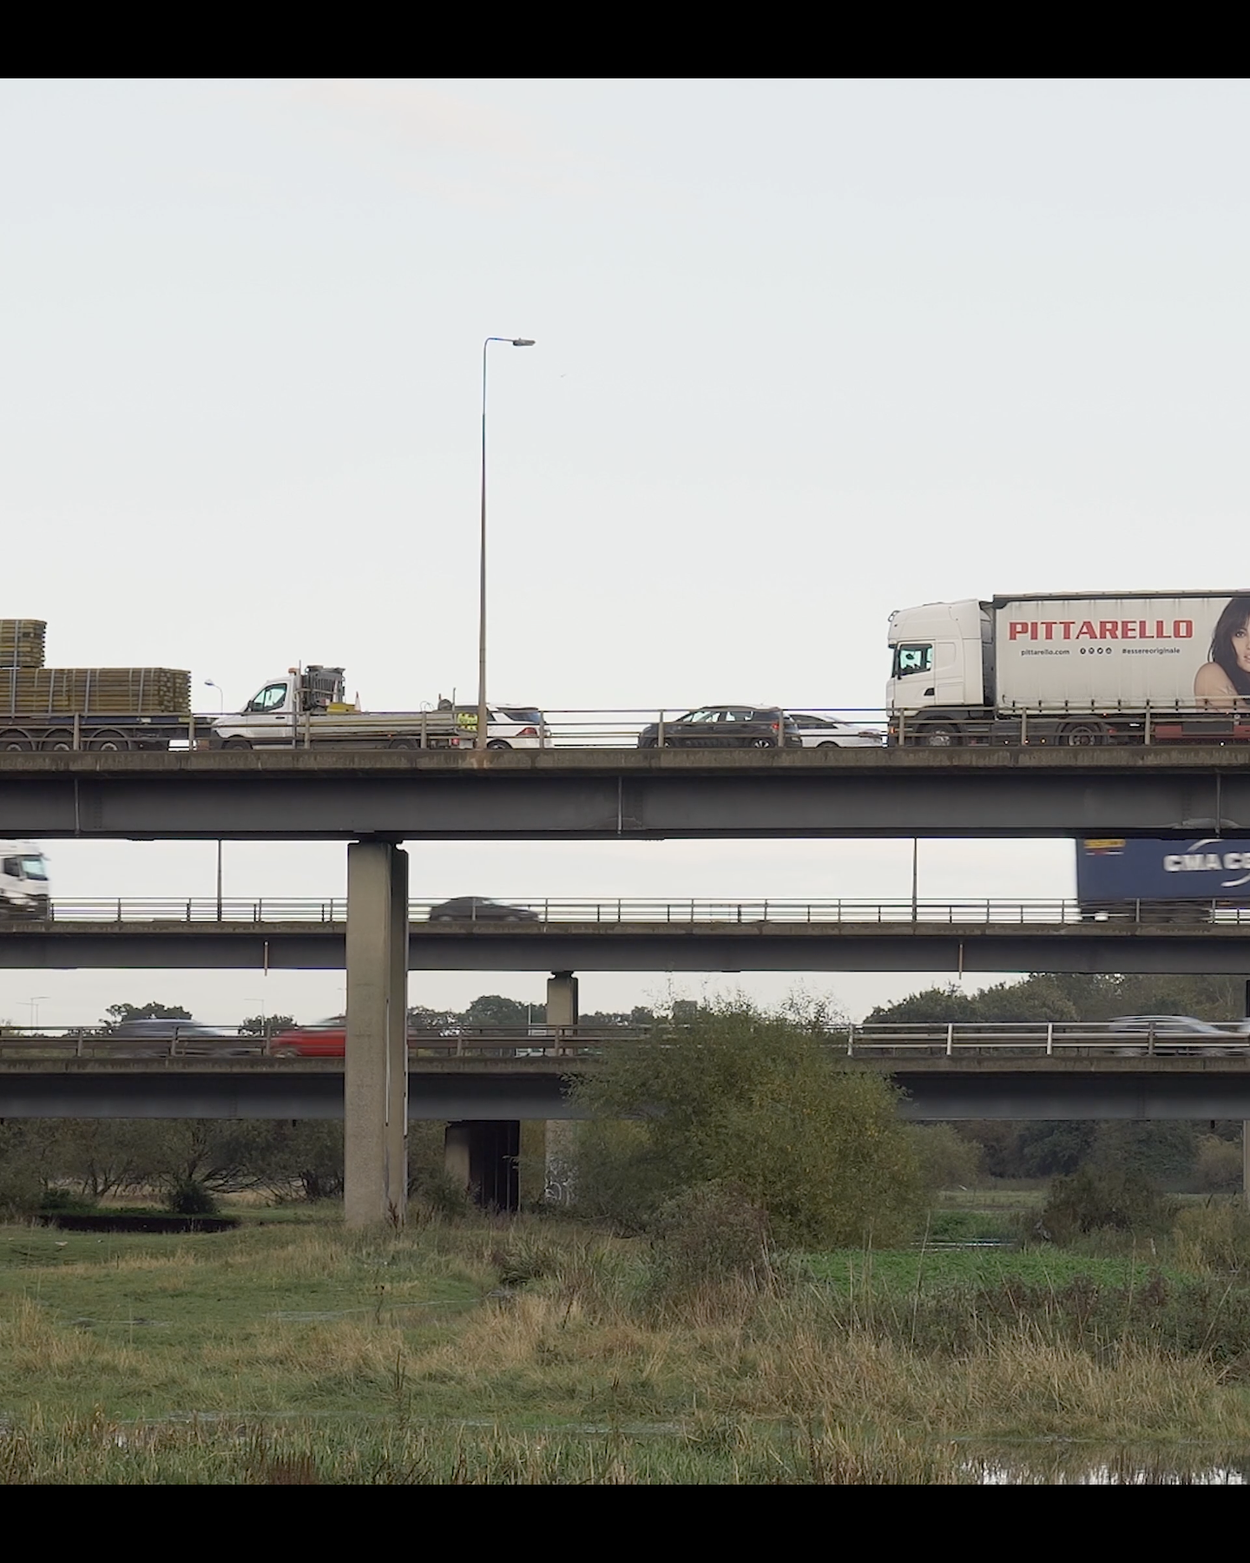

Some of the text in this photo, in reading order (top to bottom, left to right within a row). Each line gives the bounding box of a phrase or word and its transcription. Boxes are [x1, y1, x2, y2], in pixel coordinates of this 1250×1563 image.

[1008, 620, 1193, 640] PITTARELLO
[1122, 647, 1181, 655] #essereoriginale
[1163, 853, 1223, 872] CMA
